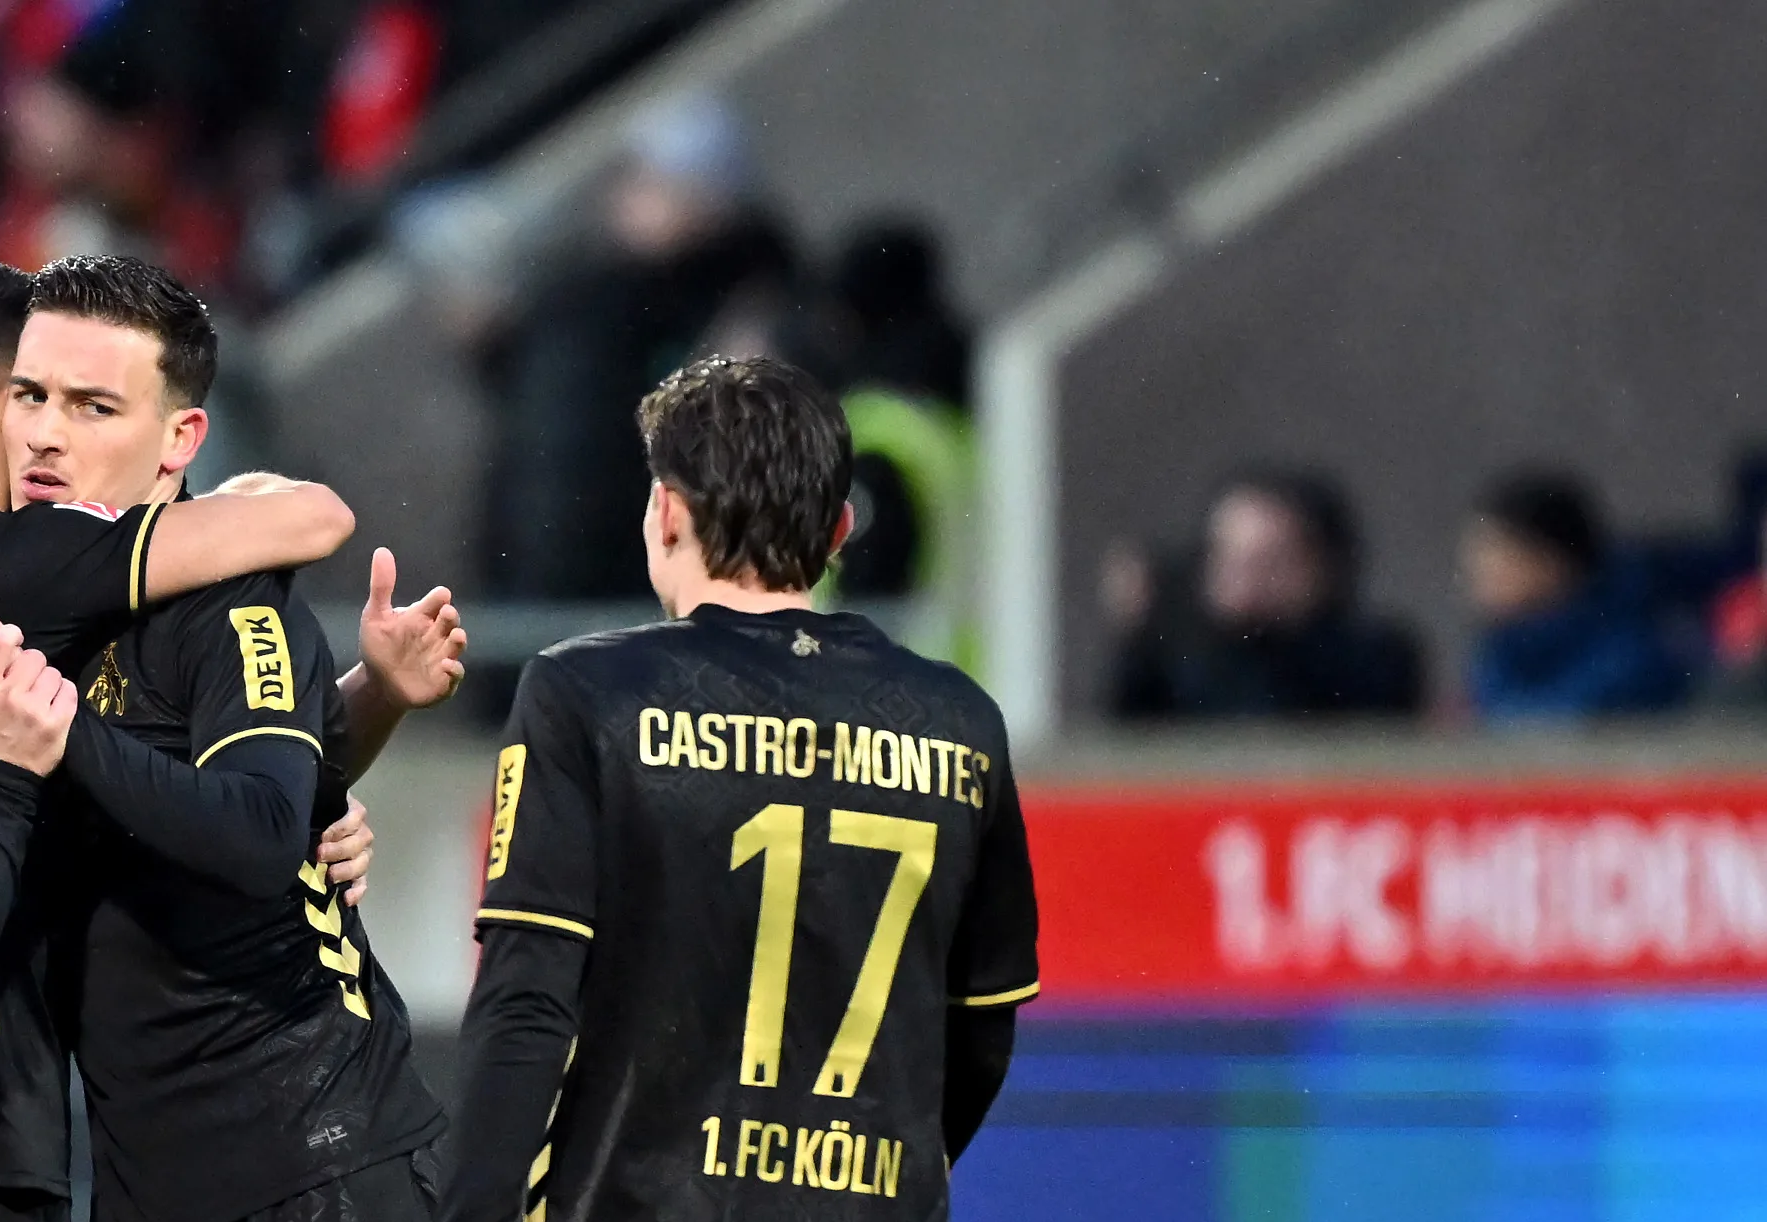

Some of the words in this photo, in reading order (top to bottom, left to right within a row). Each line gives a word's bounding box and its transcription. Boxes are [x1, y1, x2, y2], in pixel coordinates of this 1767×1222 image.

[245, 615, 284, 700] DEVK
[638, 707, 990, 809] CASTRO-MONTES
[730, 803, 938, 1098] 17
[701, 1116, 727, 1176] 1.
[735, 1119, 789, 1183] FC
[791, 1119, 903, 1198] KÖLN
